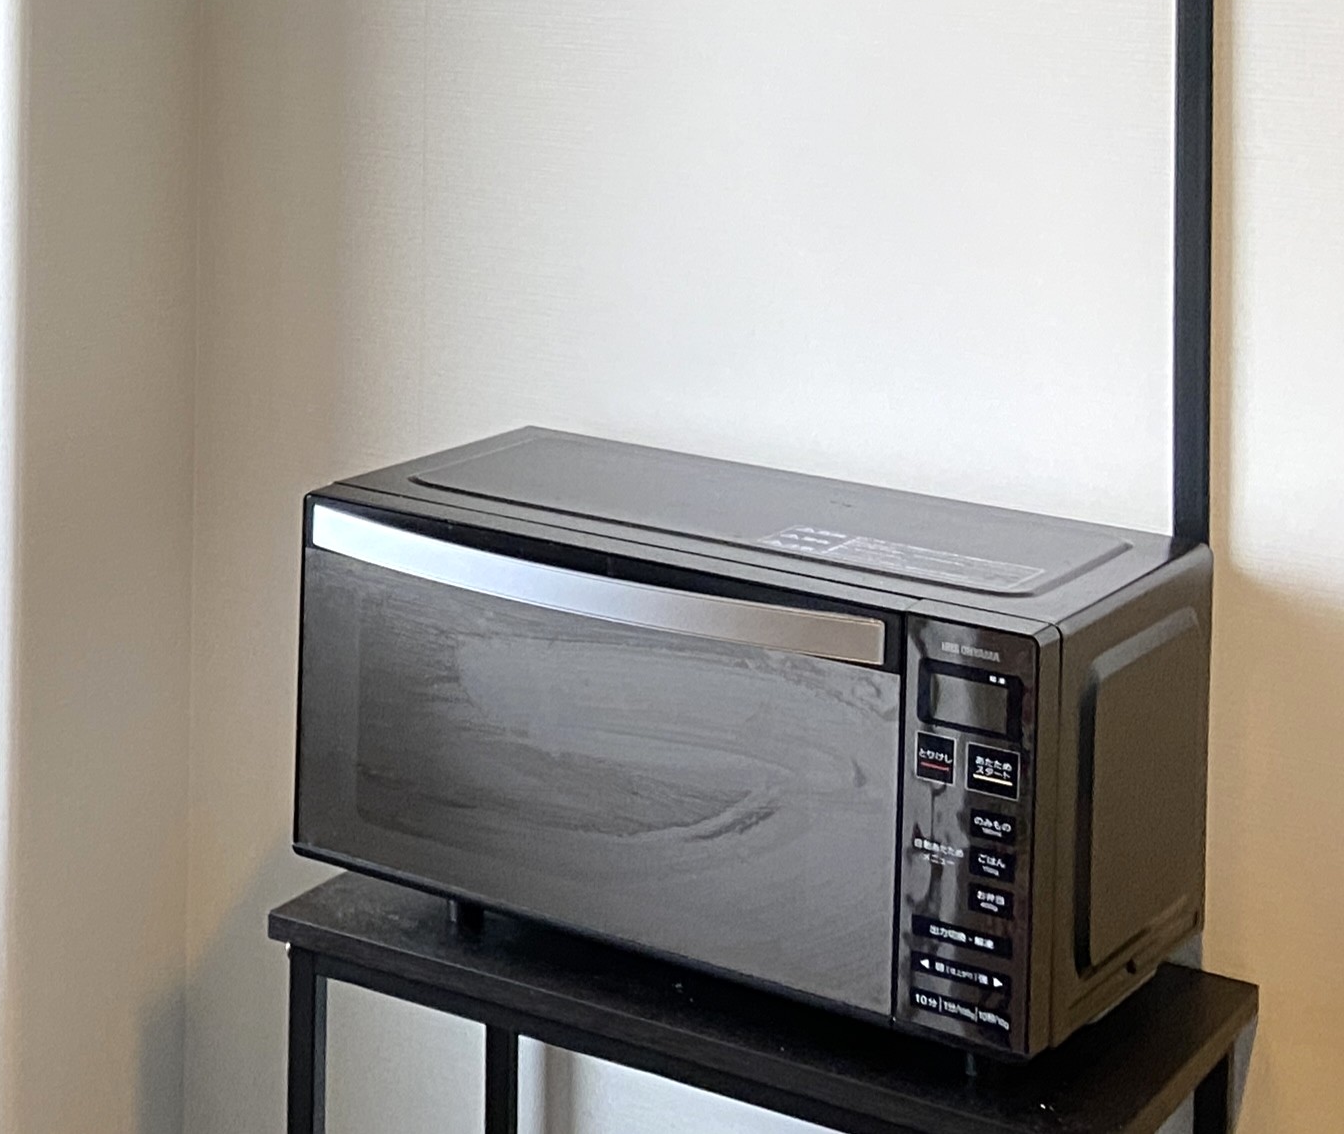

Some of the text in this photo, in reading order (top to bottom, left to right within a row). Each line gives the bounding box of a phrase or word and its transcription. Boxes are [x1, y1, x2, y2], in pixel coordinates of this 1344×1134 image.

[918, 747, 953, 764] とりけし
[975, 755, 1013, 772] あたため
[975, 765, 1011, 780] スタート
